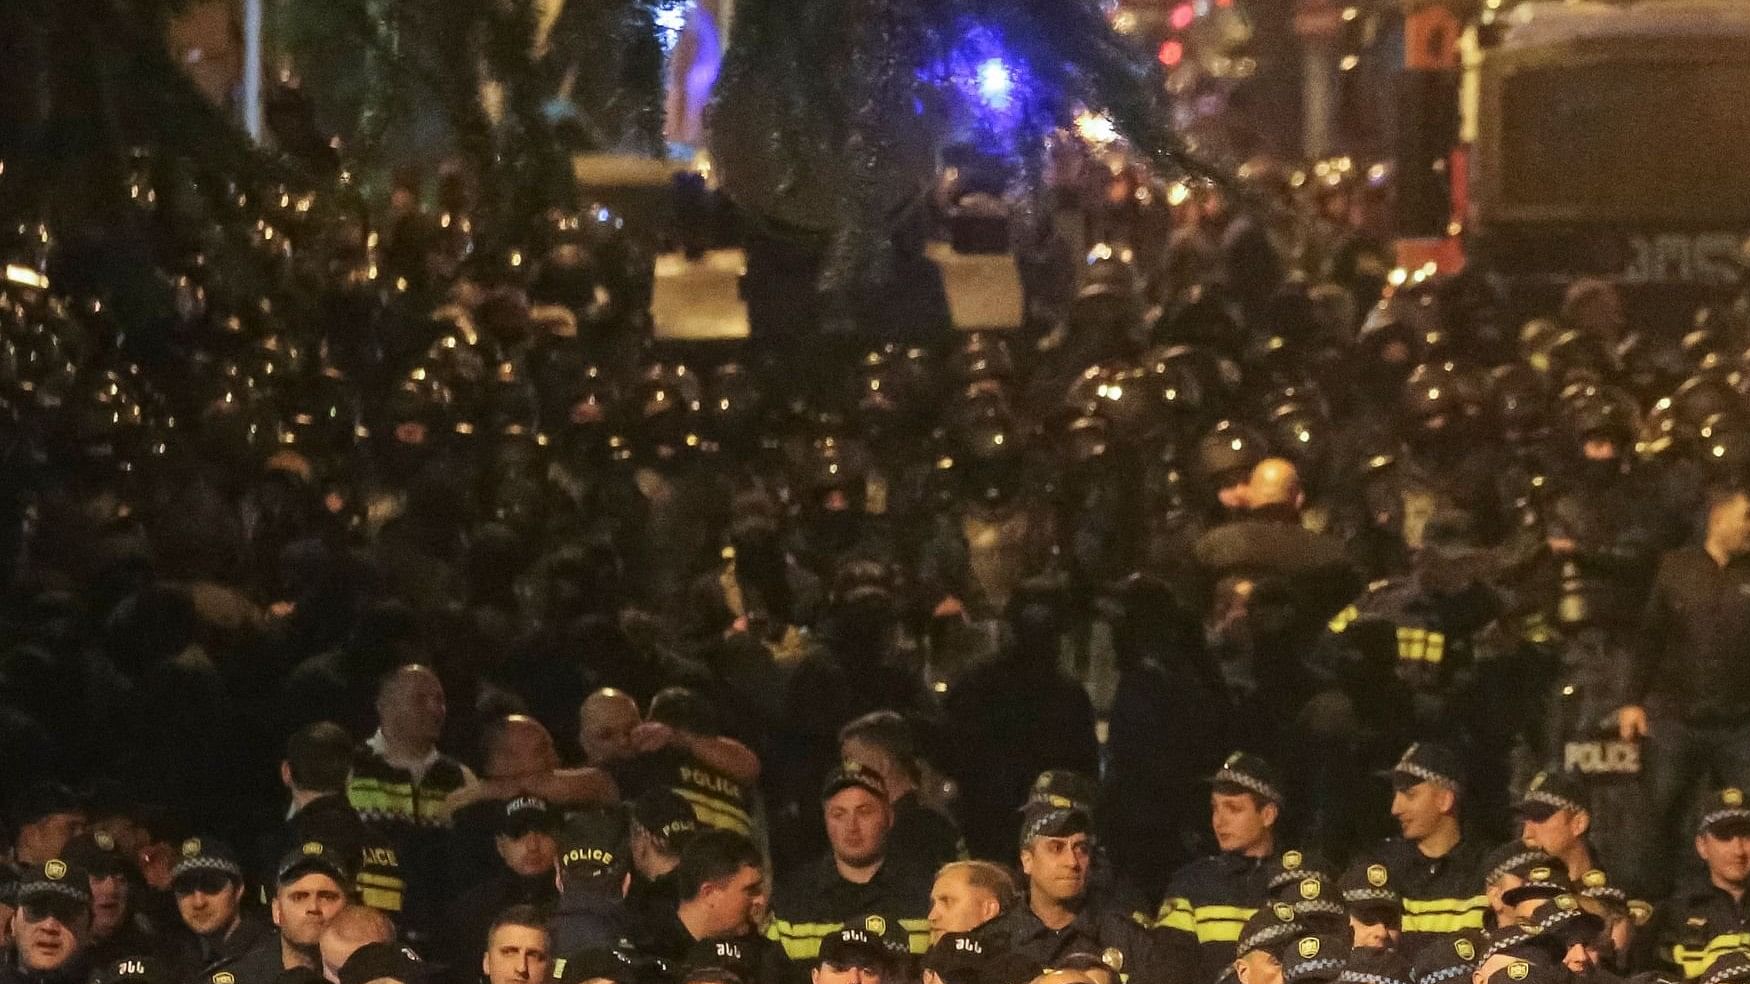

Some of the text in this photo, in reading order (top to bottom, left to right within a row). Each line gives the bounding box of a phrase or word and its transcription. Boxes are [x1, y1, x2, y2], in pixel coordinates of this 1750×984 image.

[1564, 741, 1640, 773] POLICE
[362, 848, 398, 867] LICE
[564, 848, 613, 866] POLICE
